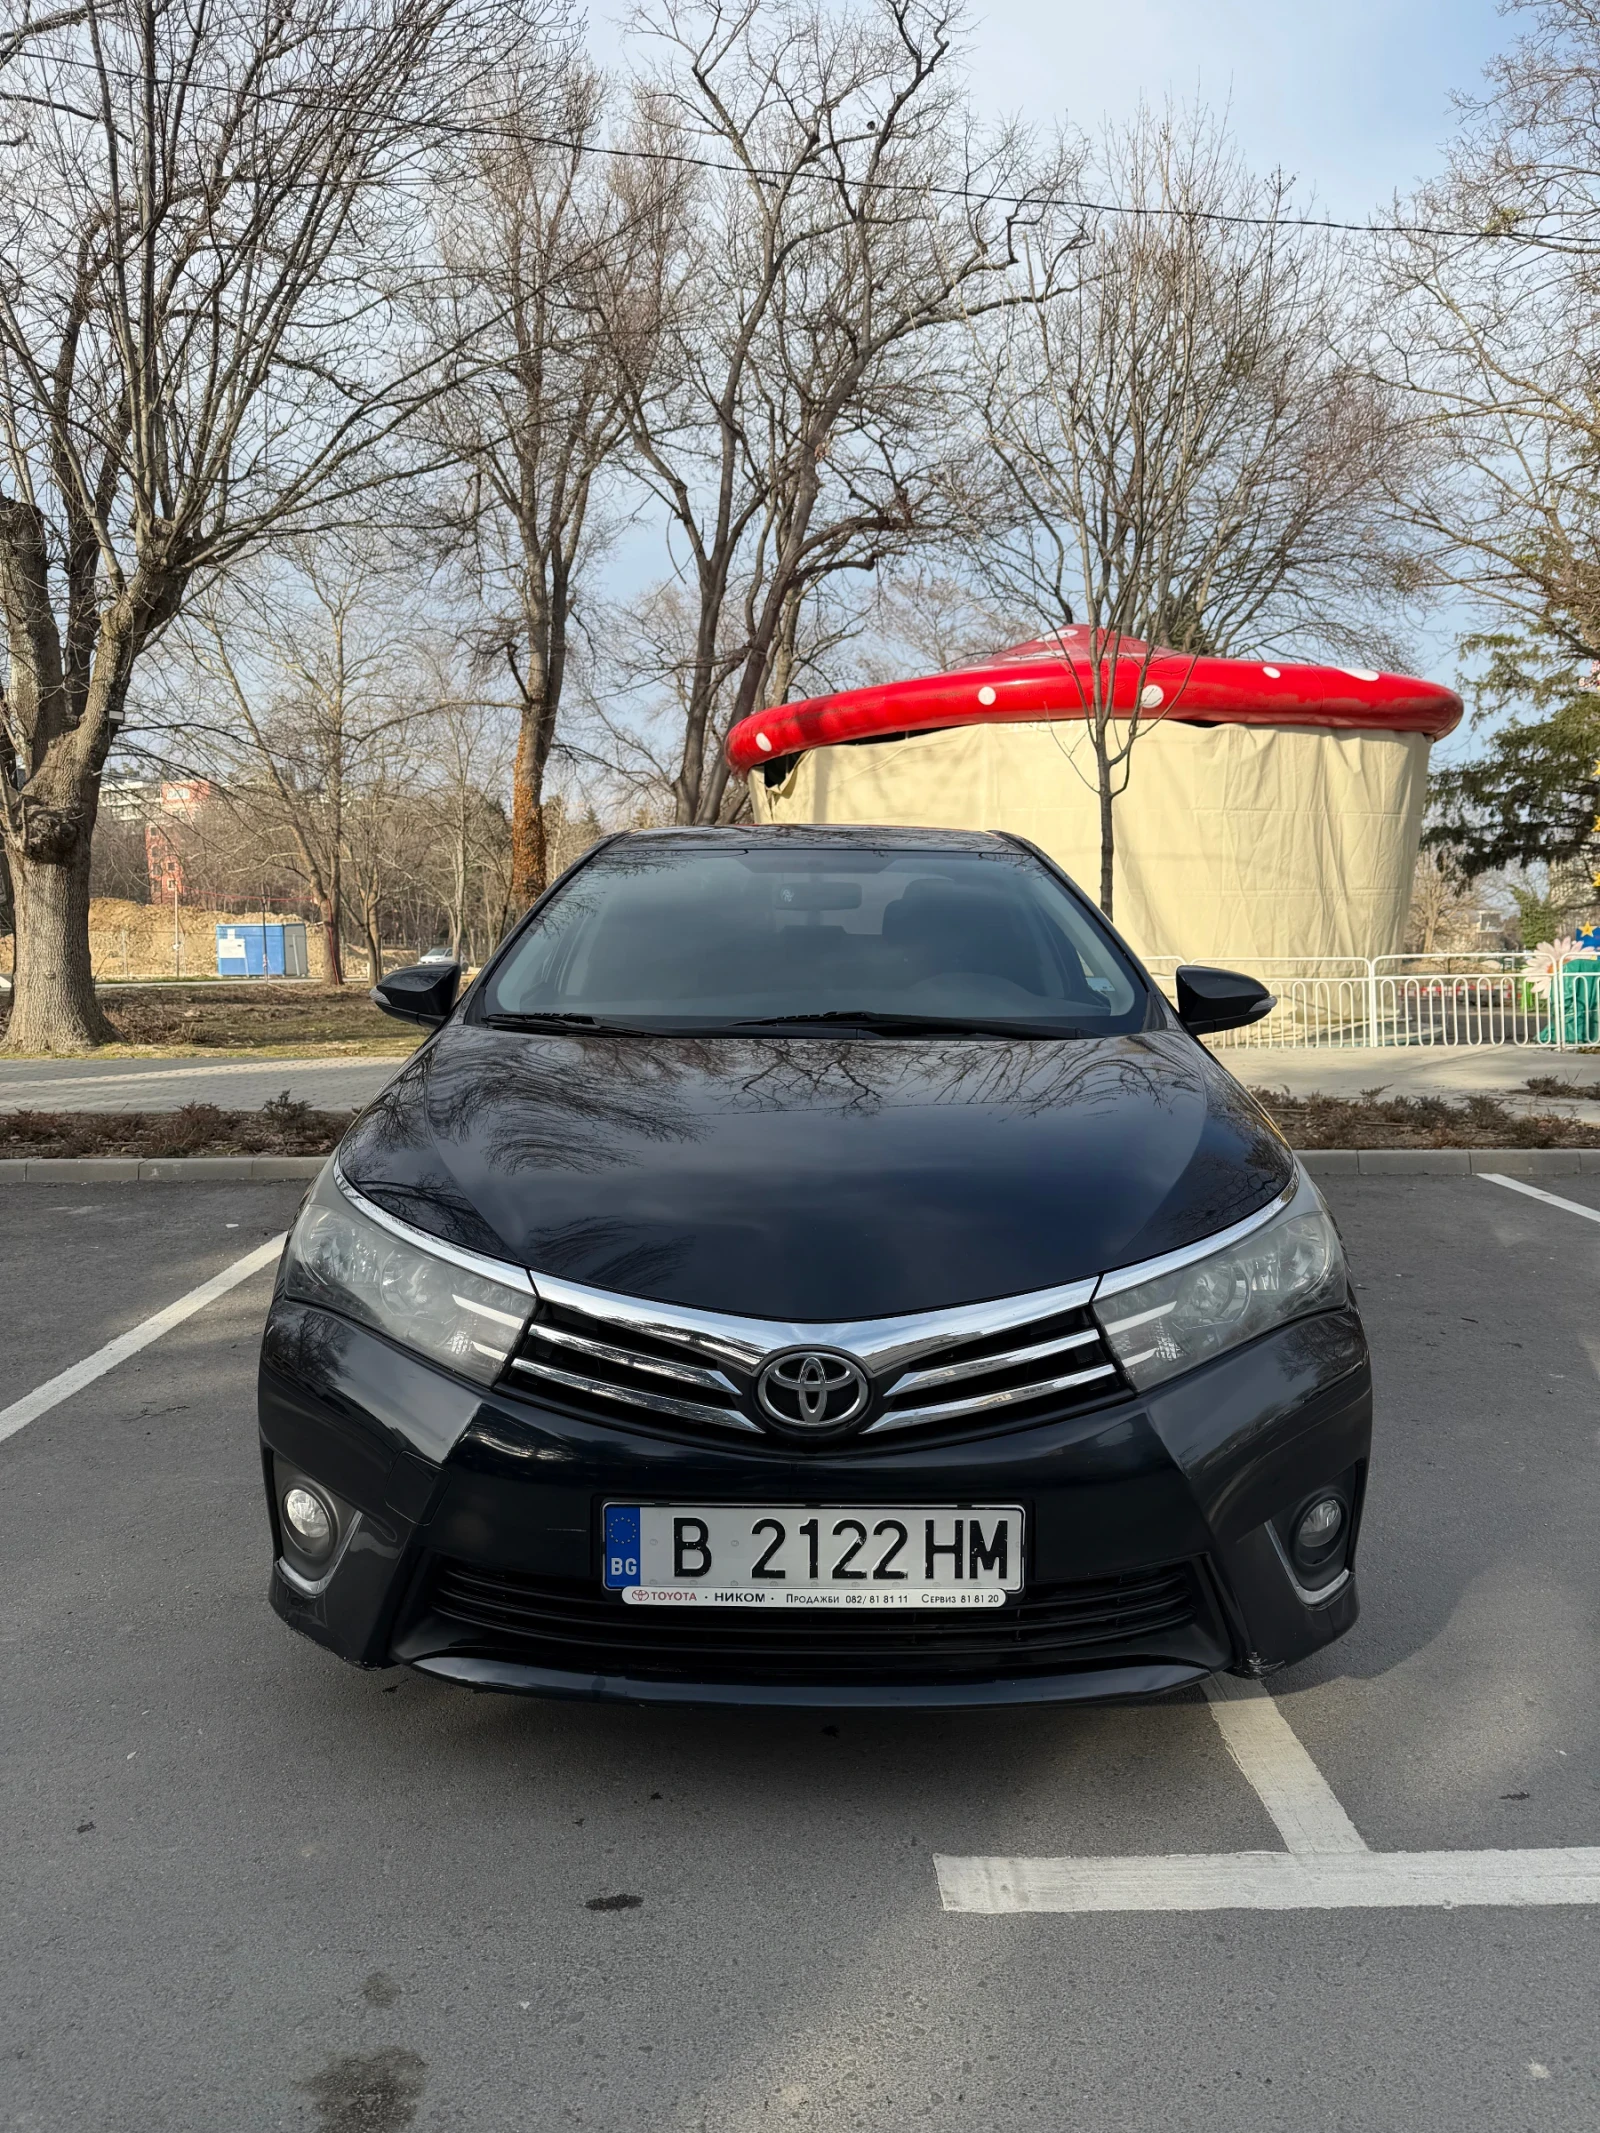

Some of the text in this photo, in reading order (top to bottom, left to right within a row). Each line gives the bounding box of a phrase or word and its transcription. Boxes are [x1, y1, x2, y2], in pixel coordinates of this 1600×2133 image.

[673, 1517, 1008, 1580] B 2122 HM
[611, 1557, 637, 1576] BG
[651, 1592, 697, 1601] TOYOTA
[714, 1593, 765, 1603] НИКОМ
